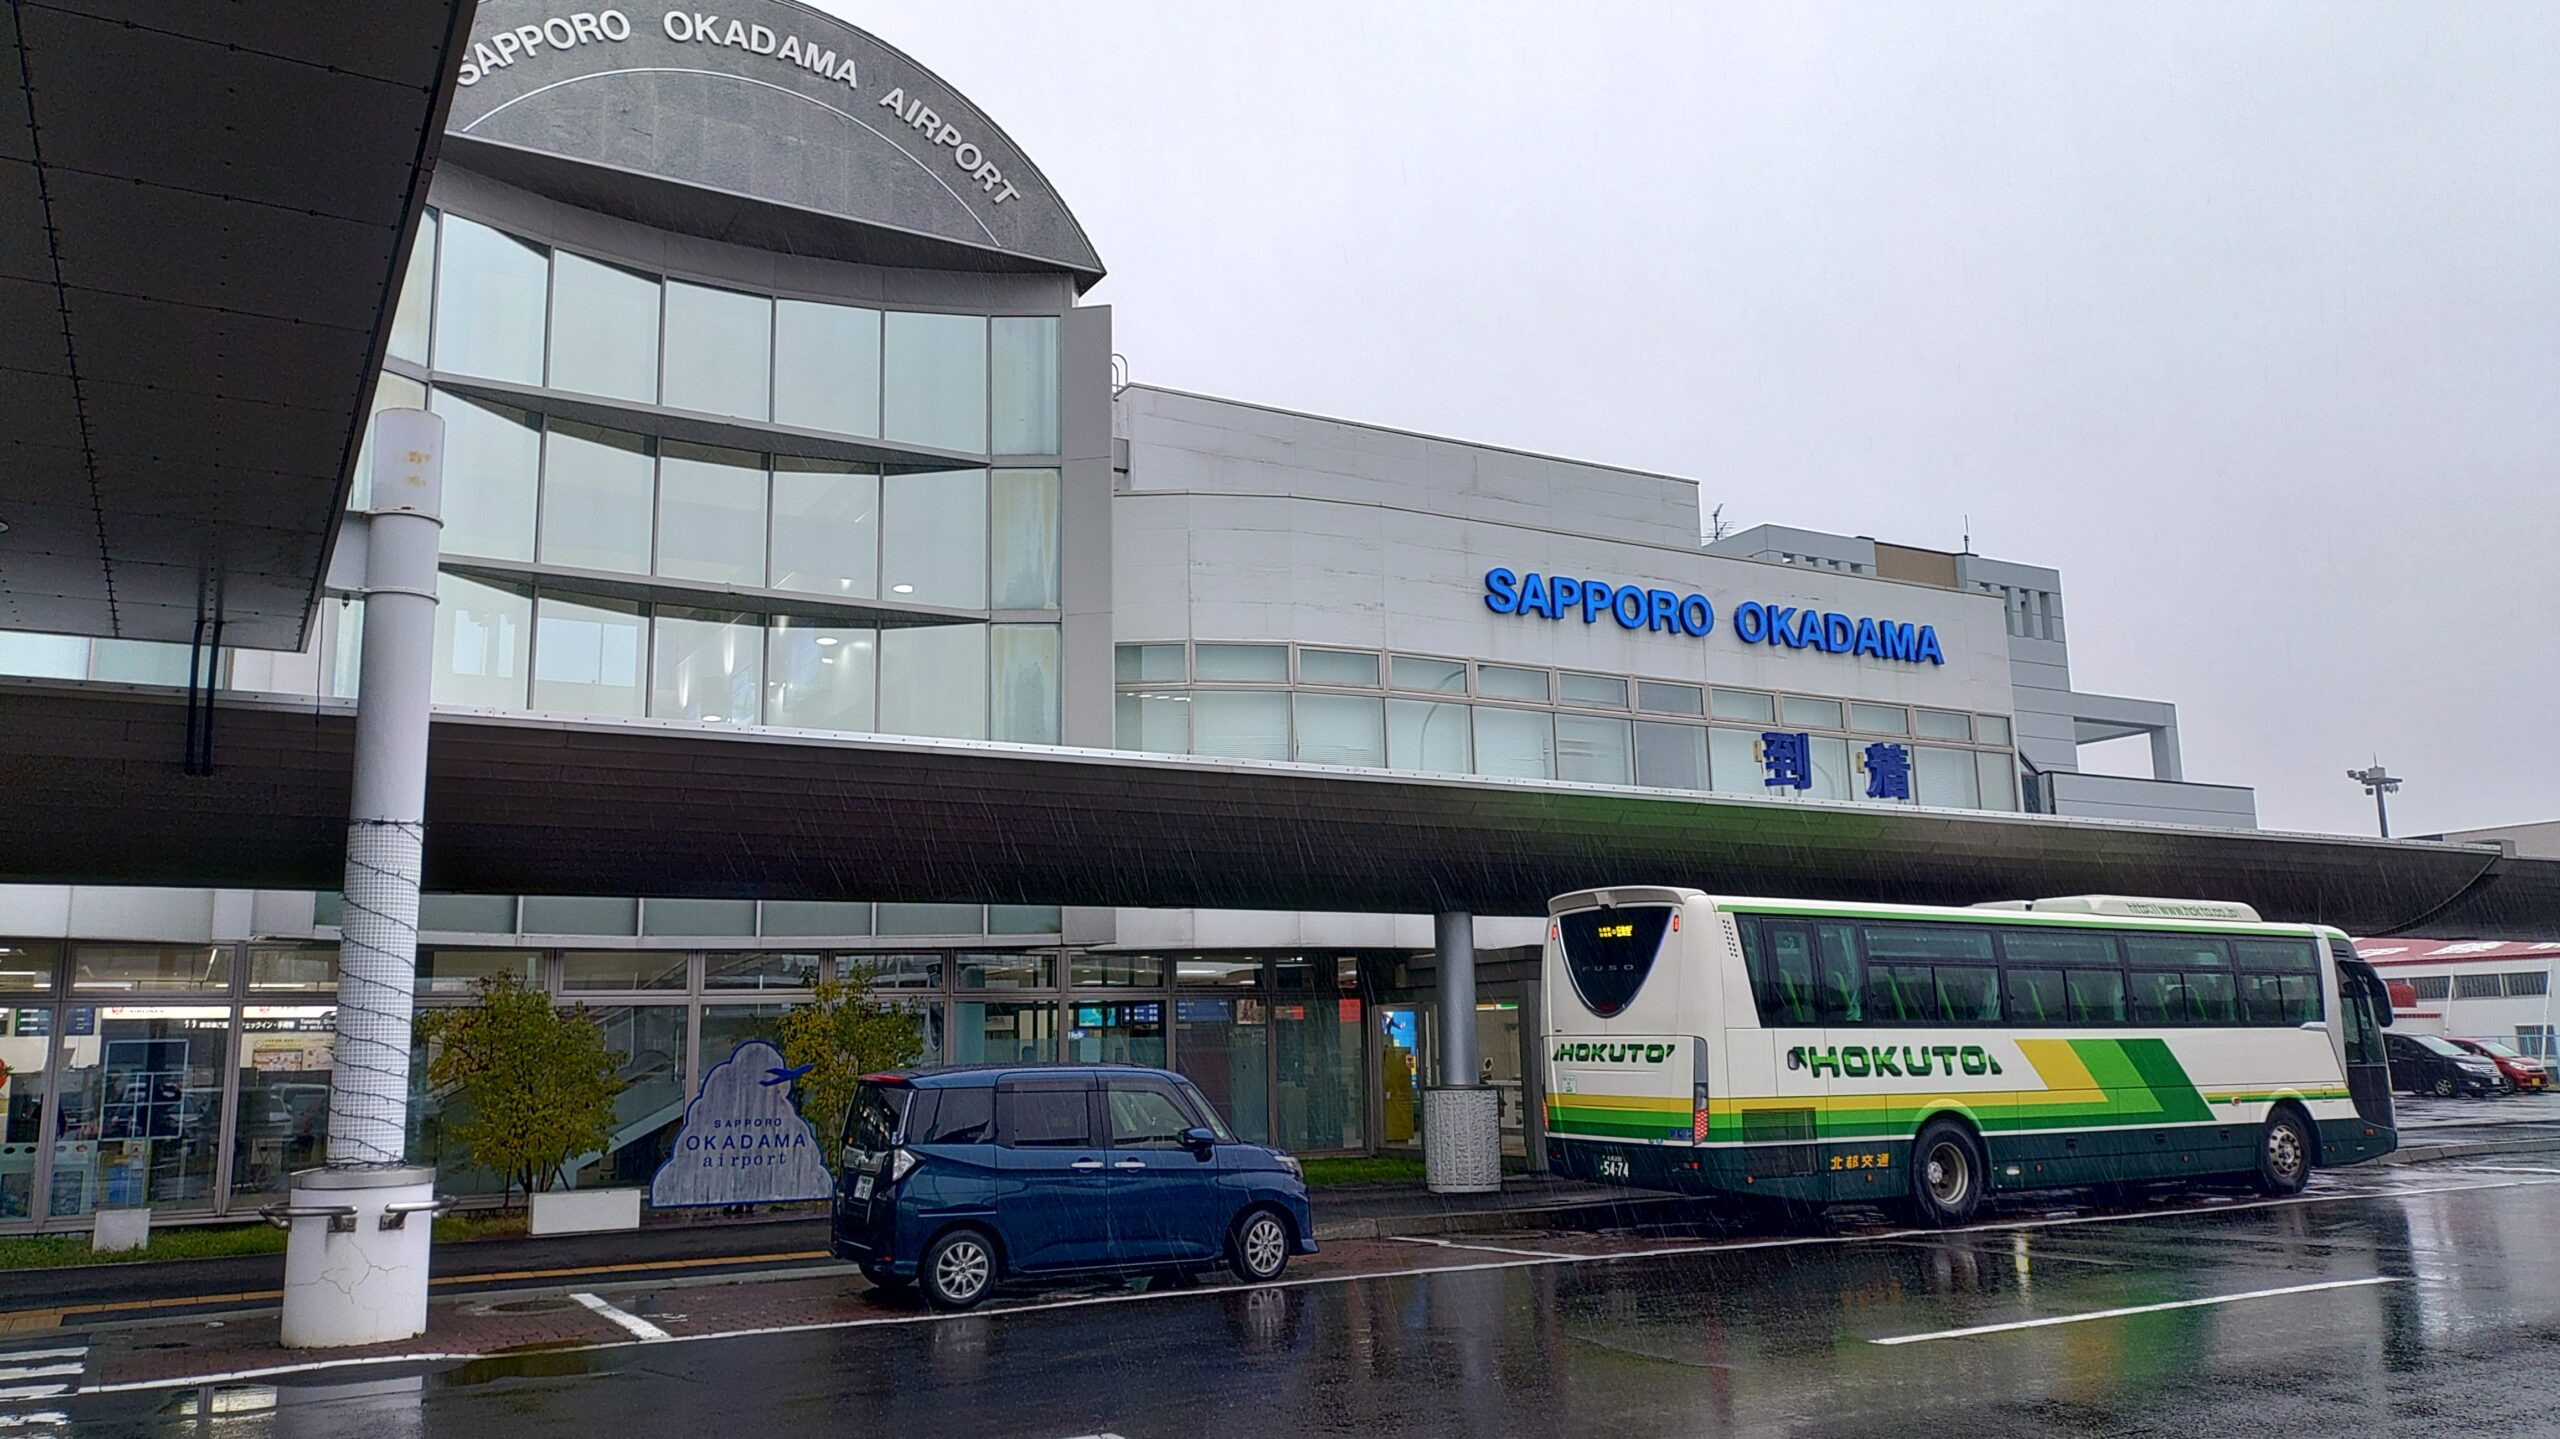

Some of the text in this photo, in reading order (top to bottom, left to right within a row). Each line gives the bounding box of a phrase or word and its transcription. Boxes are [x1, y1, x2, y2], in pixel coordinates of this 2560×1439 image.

[457, 10, 1021, 204] SAPPORO OKADAMA AIRPORT
[1484, 567, 1945, 666] SAPPORO OKADAMA
[1761, 731, 1911, 800] 到着
[1582, 964, 1634, 972] FUSO
[1558, 1043, 1665, 1063] HOKUTO
[1808, 1046, 1987, 1078] HOKUTO
[714, 1118, 782, 1129] SAPPORO
[686, 1133, 806, 1151] OKADAMA
[703, 1152, 786, 1169] airport
[1830, 1153, 1889, 1170] 北都交通
